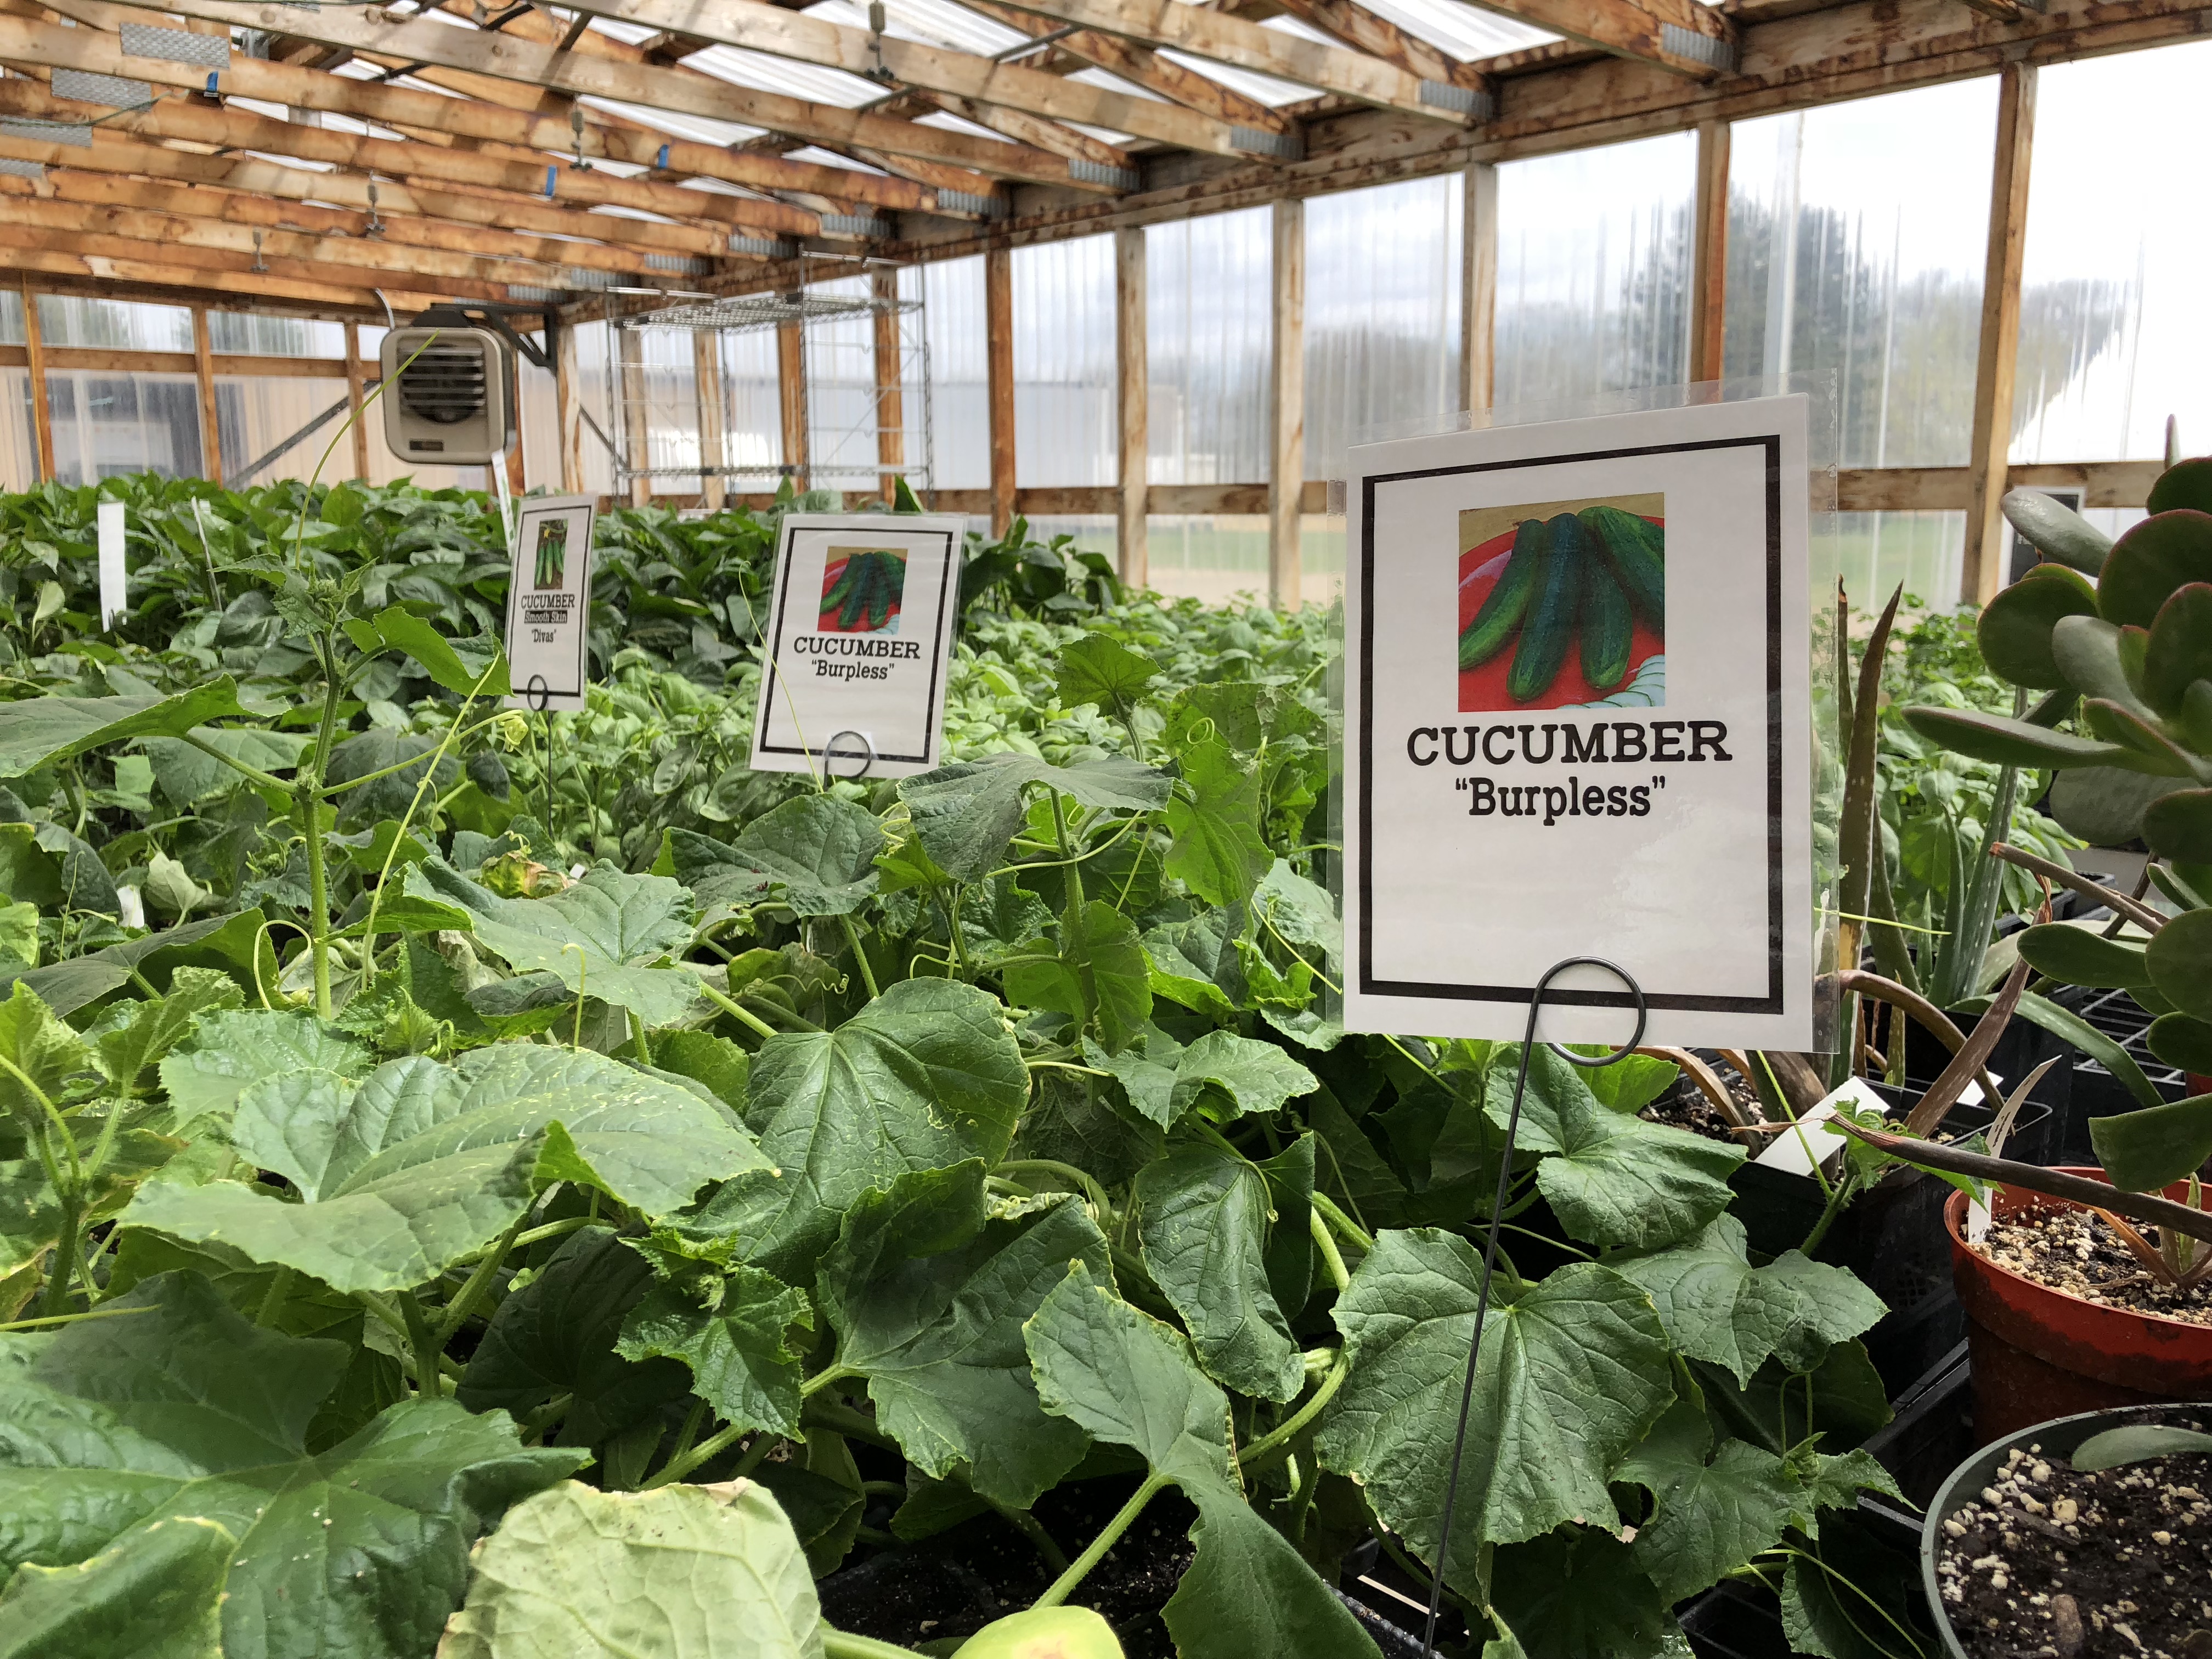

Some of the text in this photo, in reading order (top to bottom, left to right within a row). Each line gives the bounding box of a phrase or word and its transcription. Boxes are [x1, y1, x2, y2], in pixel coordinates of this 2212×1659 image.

[521, 594, 575, 609] CUCUMBER
[525, 611, 567, 623] Smooth Skin
[793, 636, 921, 659] CUCUMBER
[811, 659, 895, 682] “Burpless”
[1407, 720, 1733, 766] CUCUMBER
[1455, 776, 1666, 826] “Burpless”
